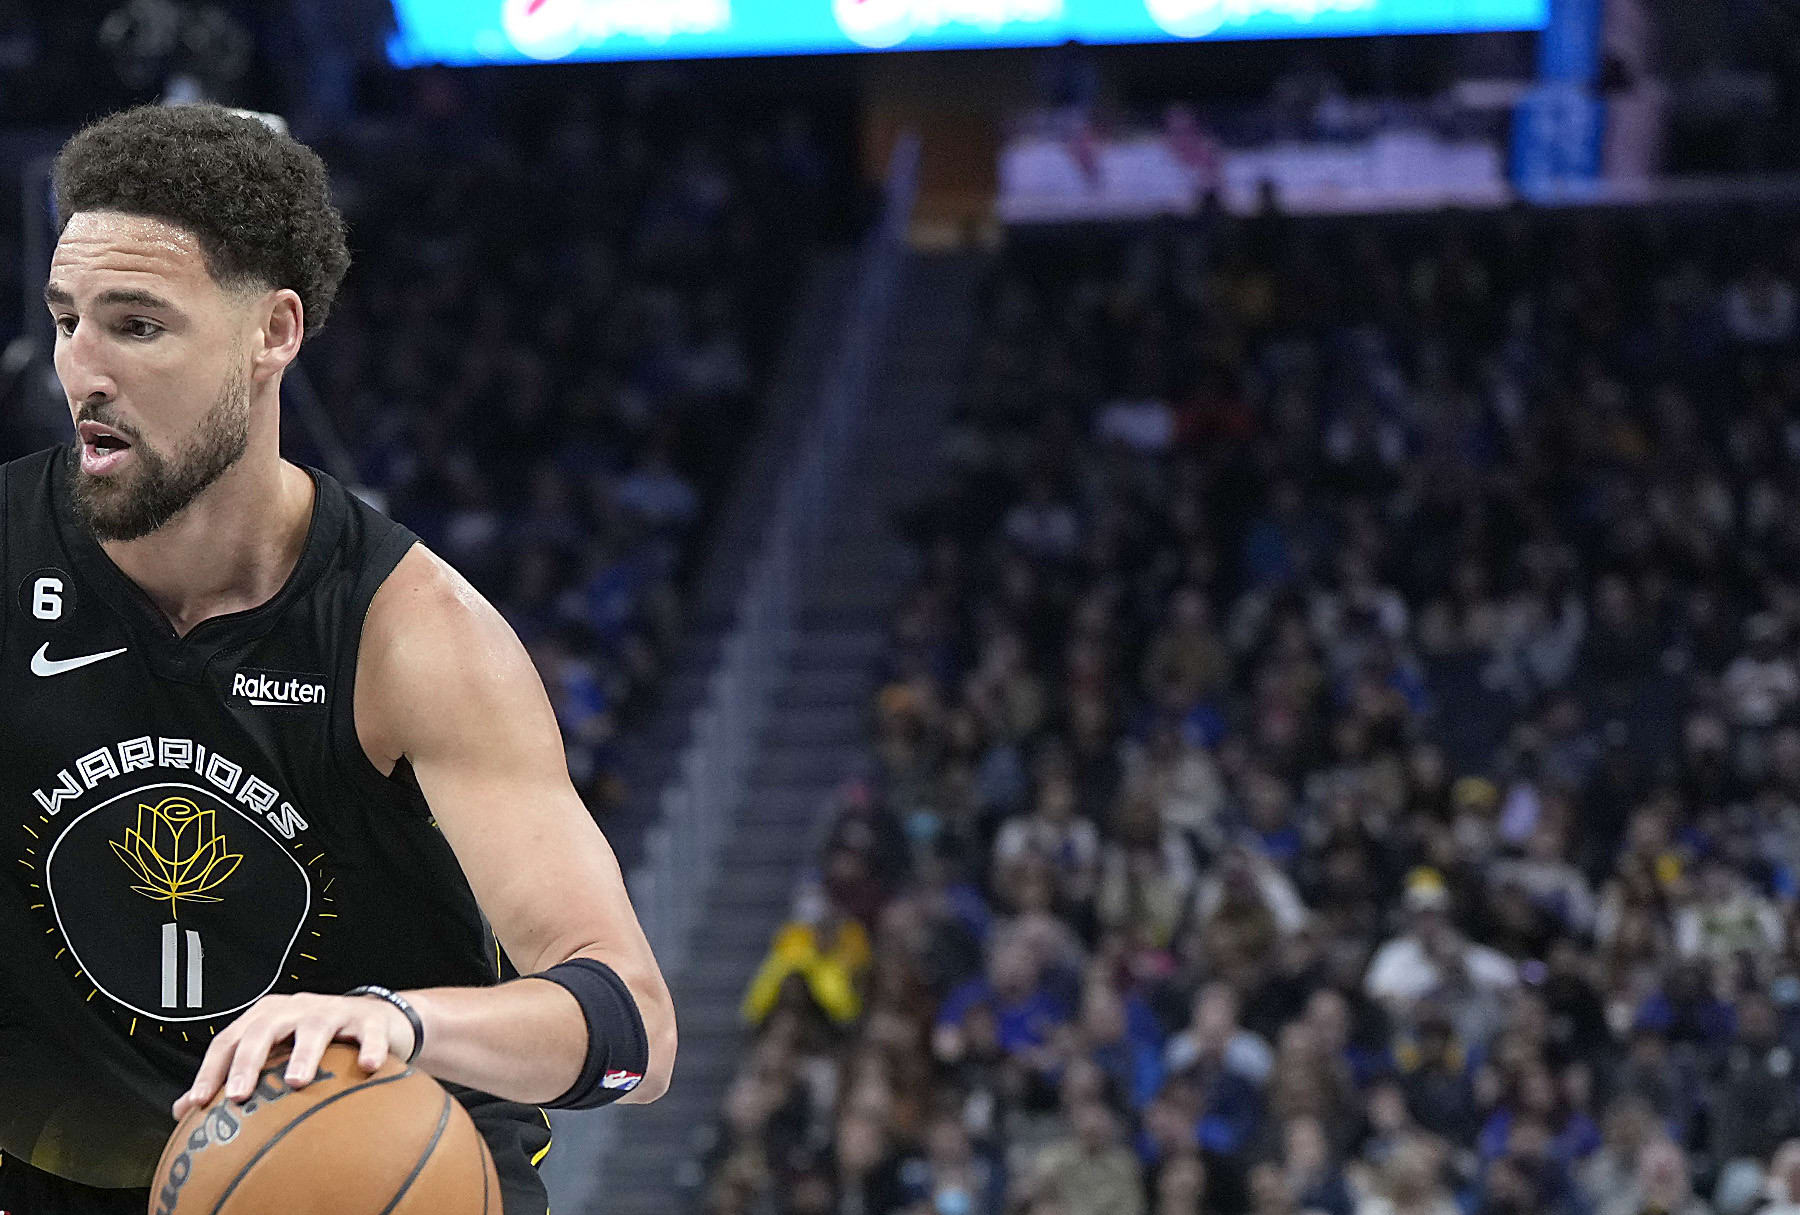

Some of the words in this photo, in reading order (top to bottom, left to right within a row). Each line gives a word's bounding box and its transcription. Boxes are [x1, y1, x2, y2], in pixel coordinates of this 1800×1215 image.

[33, 578, 63, 619] 6
[232, 673, 326, 704] Rakuten
[32, 735, 309, 839] WARRIORS
[161, 922, 203, 1009] 11
